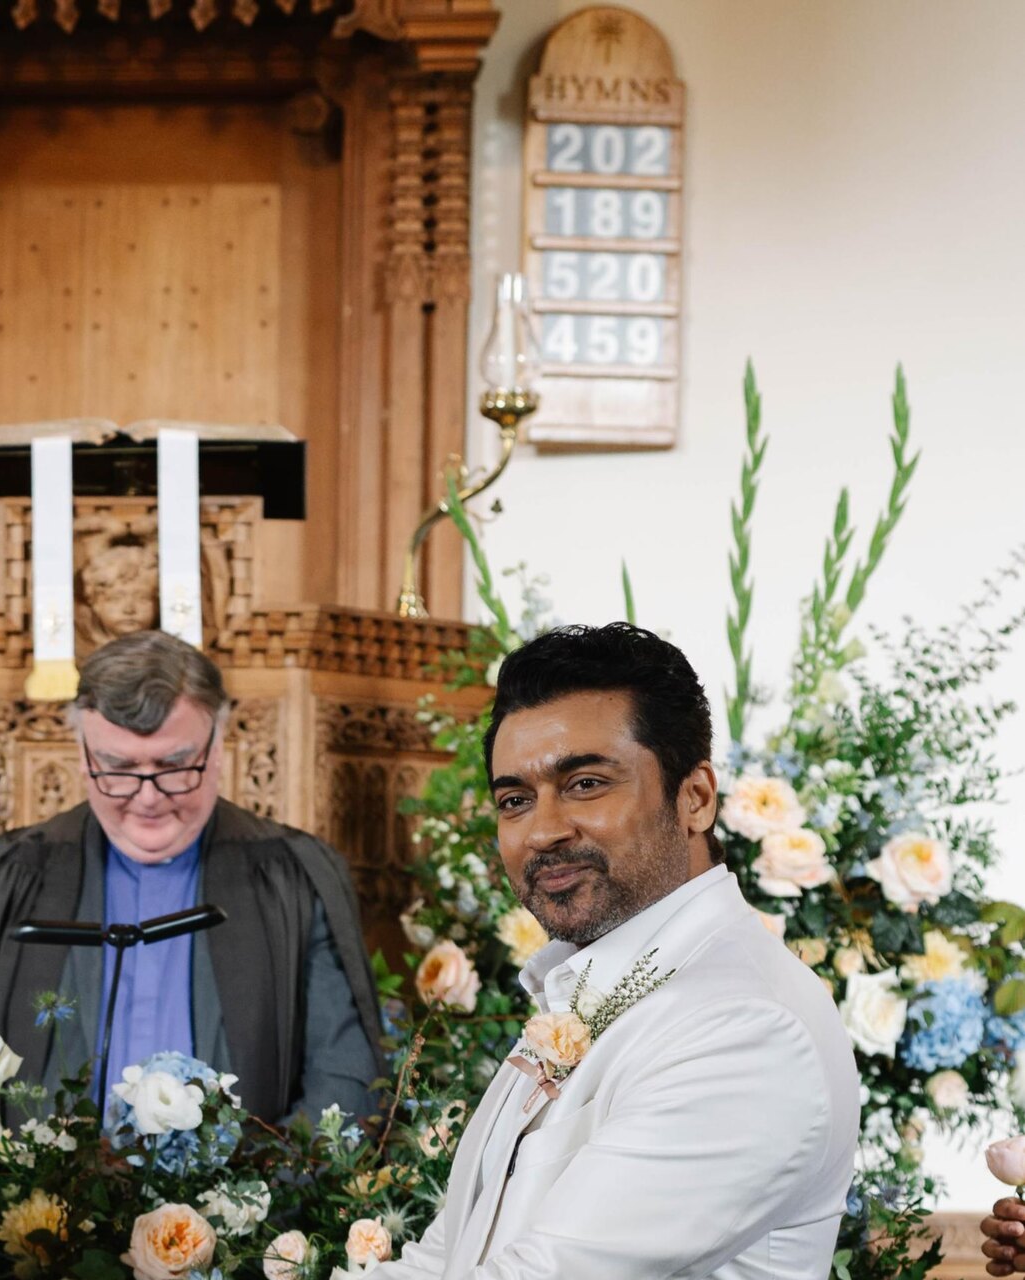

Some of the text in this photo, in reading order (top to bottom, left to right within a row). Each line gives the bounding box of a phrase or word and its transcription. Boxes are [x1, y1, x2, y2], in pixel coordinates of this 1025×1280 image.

[545, 76, 672, 103] HYMNS
[552, 126, 665, 173] 202
[551, 190, 663, 237] 189
[548, 253, 662, 299] 520
[545, 317, 661, 364] 459
